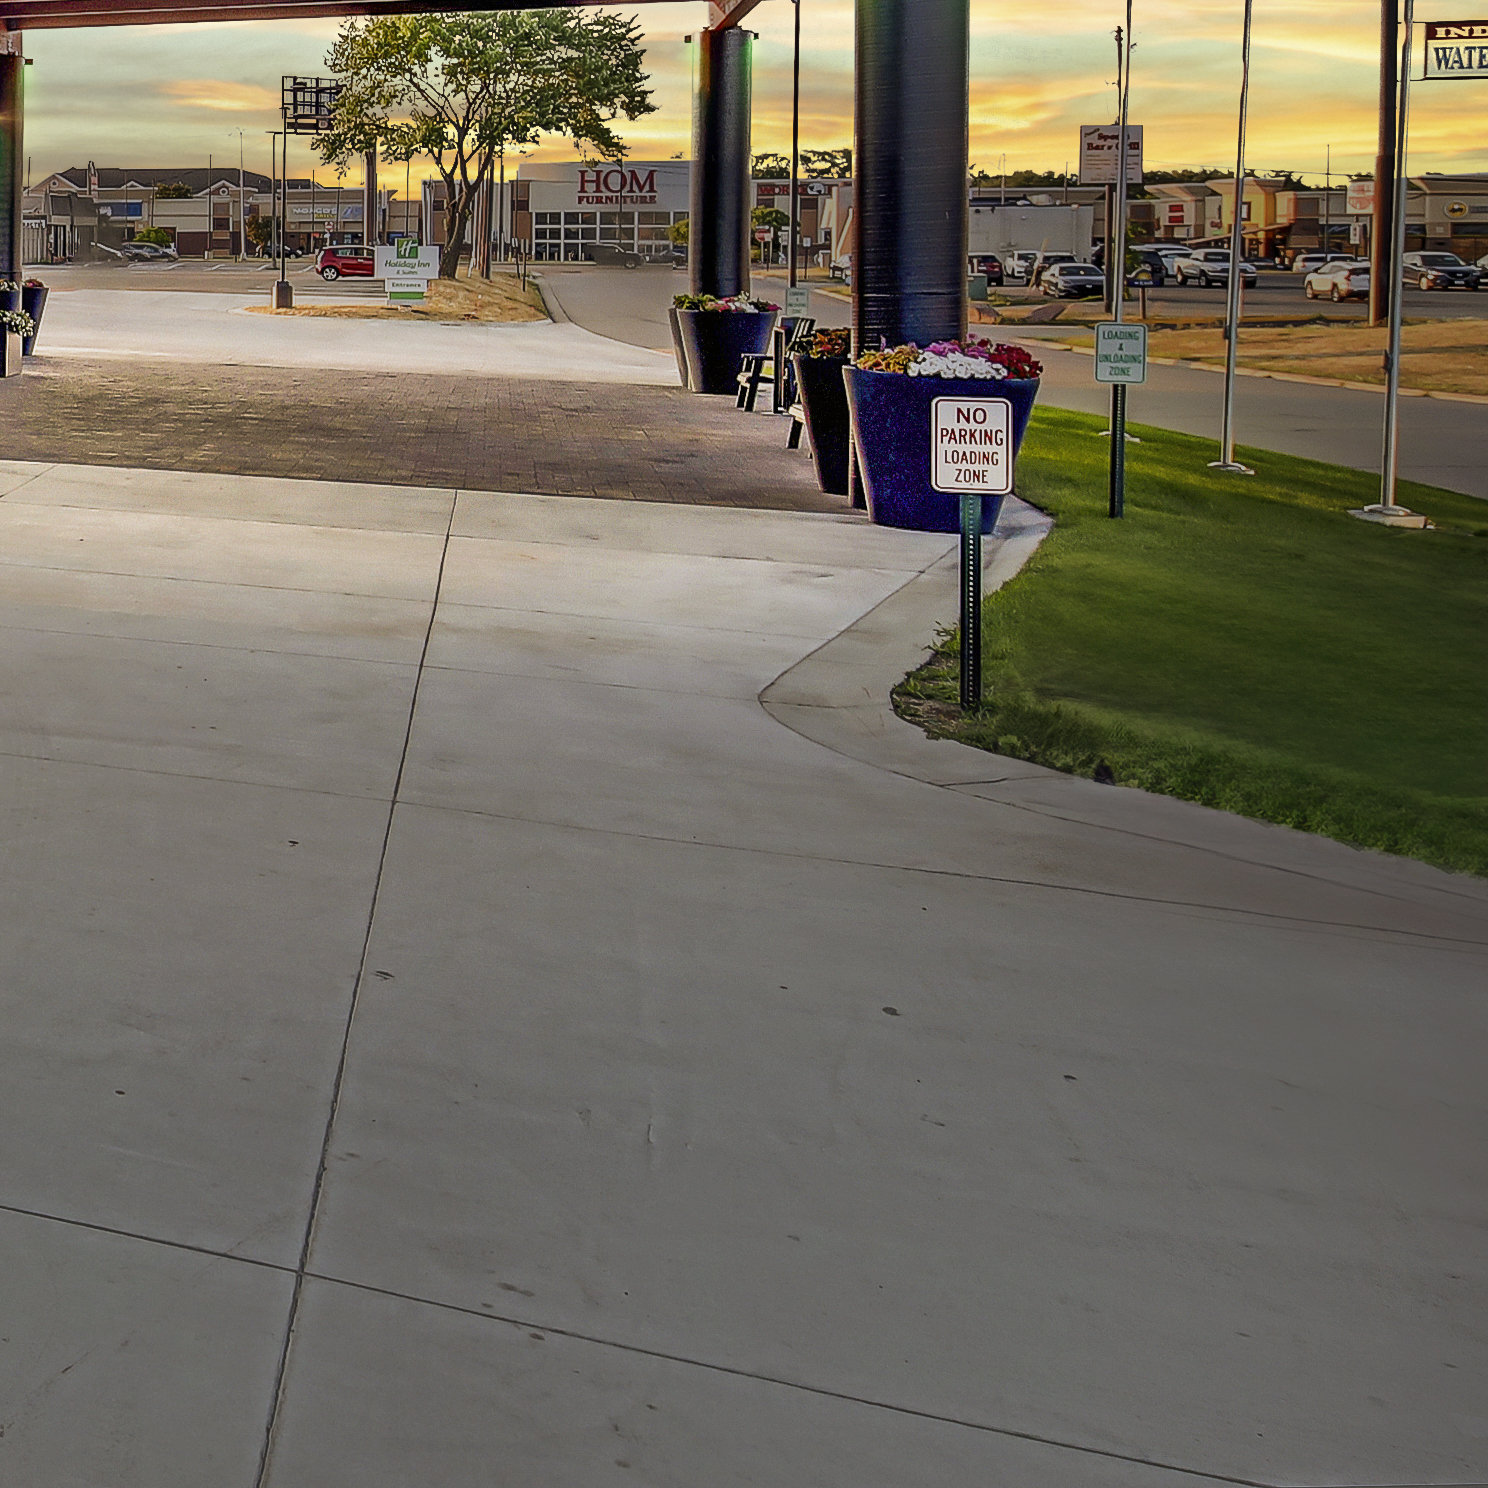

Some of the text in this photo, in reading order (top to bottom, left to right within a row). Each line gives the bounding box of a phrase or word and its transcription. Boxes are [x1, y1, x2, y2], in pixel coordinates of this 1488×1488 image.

[577, 169, 658, 193] HOM
[577, 195, 657, 204] FURNITURE
[384, 260, 430, 269] Holiday Inn
[1102, 330, 1140, 340] LOADING
[1098, 353, 1142, 363] UNLOADING
[1109, 366, 1131, 376] ZONE
[956, 407, 987, 424] NO
[940, 428, 1004, 446] PARKING
[944, 449, 999, 466] LOADING
[954, 468, 989, 484] ZONE
